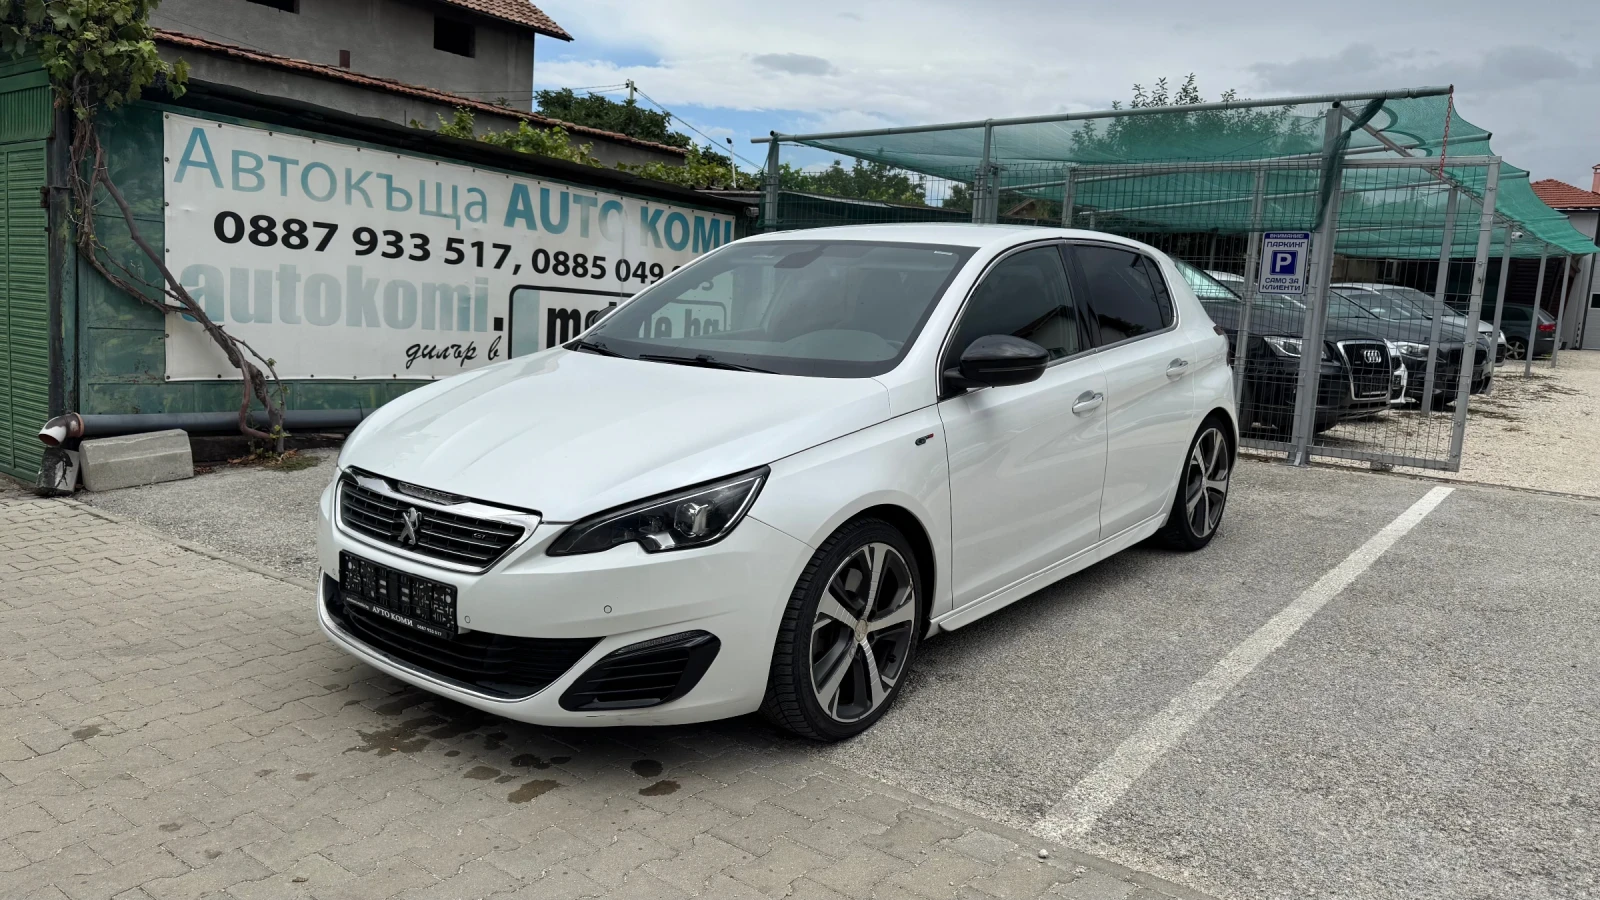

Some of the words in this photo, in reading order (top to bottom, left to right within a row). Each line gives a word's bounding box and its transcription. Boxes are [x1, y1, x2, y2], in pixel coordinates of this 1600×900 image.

[173, 127, 488, 230] Автокъща
[504, 183, 625, 242] AUTO
[640, 206, 732, 254] KOMI
[213, 211, 338, 252] 0887
[352, 226, 431, 262] 933
[444, 237, 521, 275] 517,
[531, 248, 607, 280] 0885
[615, 258, 664, 284] 049
[405, 341, 477, 369] дилър
[391, 612, 413, 627] КОМИ
